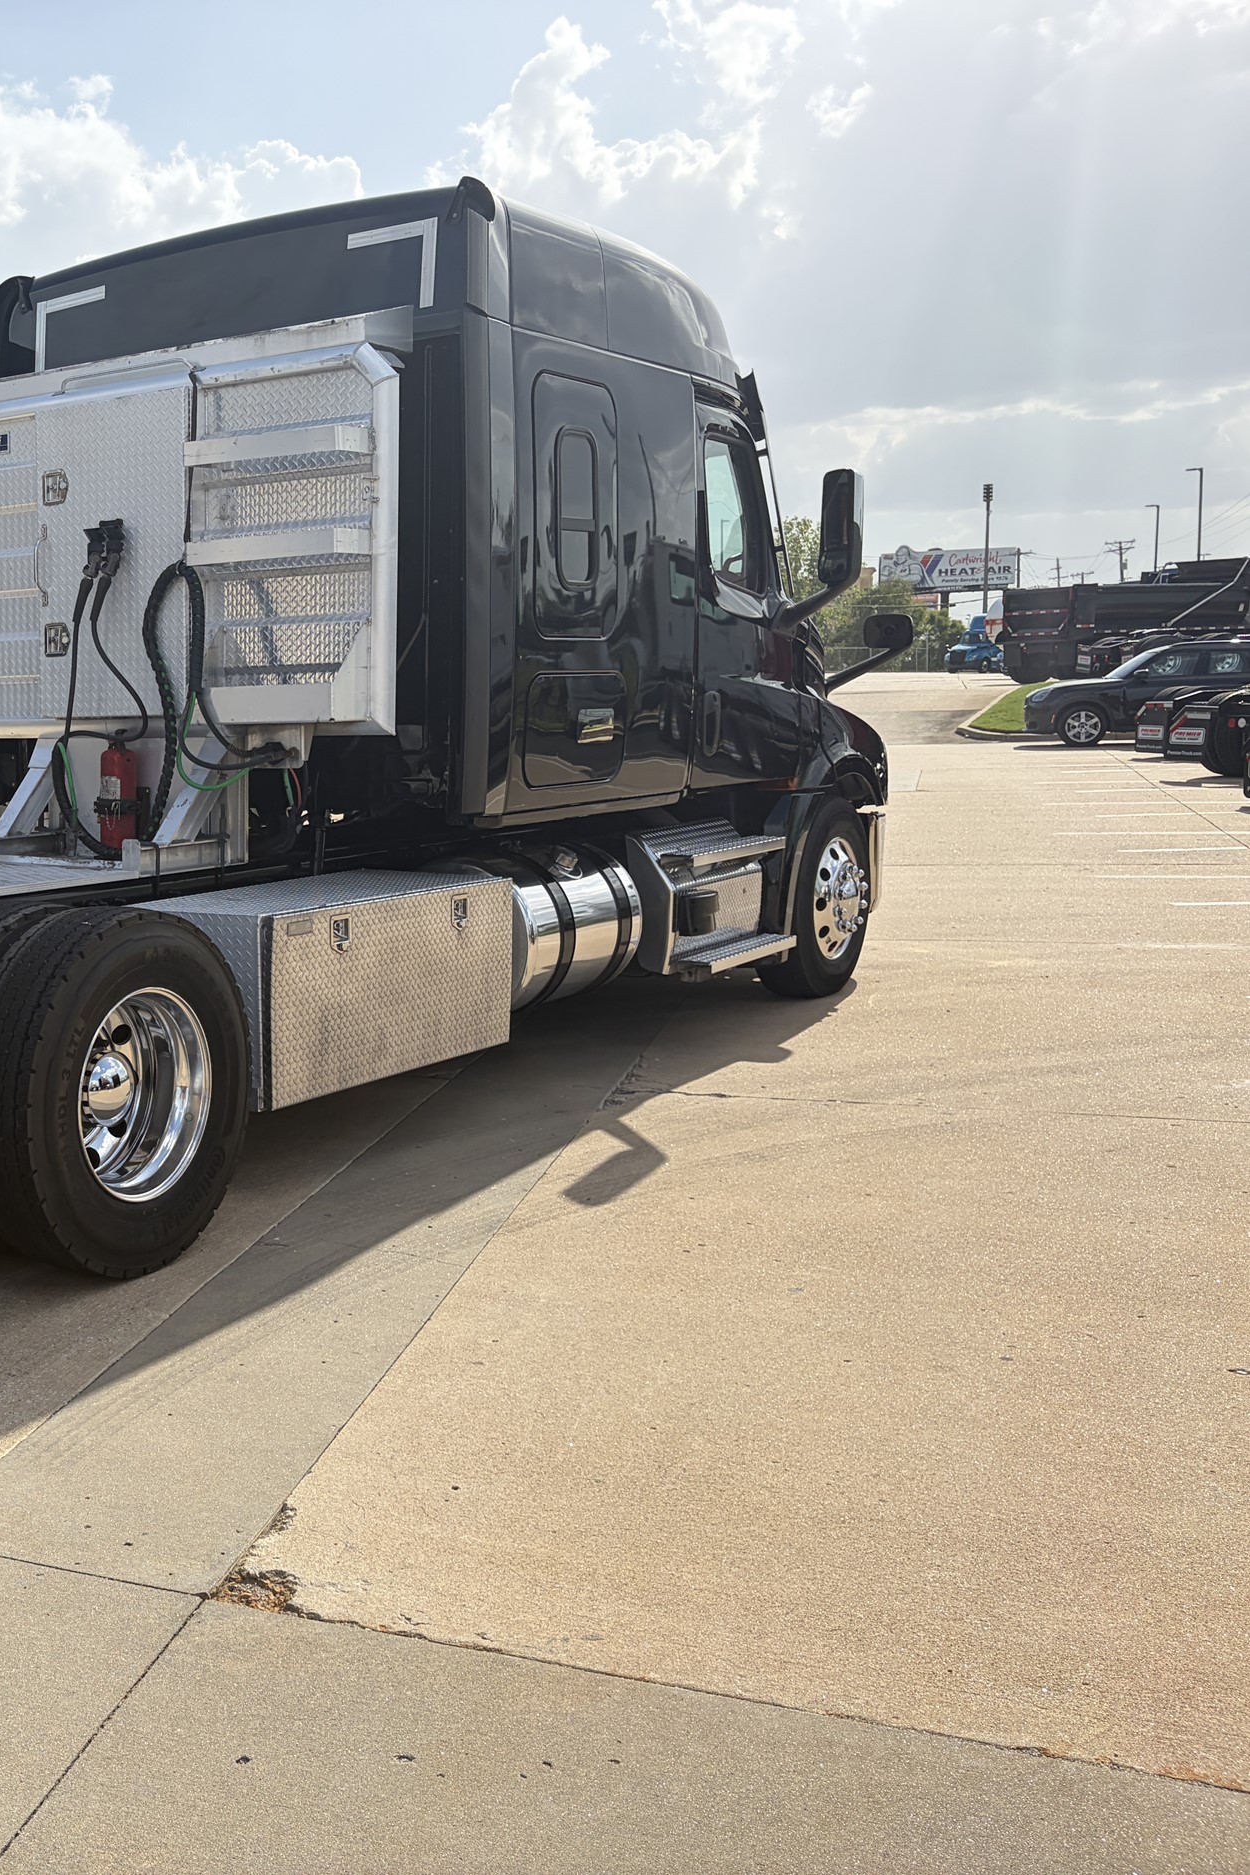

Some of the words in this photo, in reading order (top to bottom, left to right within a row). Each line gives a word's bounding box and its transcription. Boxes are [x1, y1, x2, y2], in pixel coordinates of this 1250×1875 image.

[949, 551, 1001, 567] Cartwriht
[938, 567, 976, 576] HEAT
[987, 564, 1012, 574] AIR
